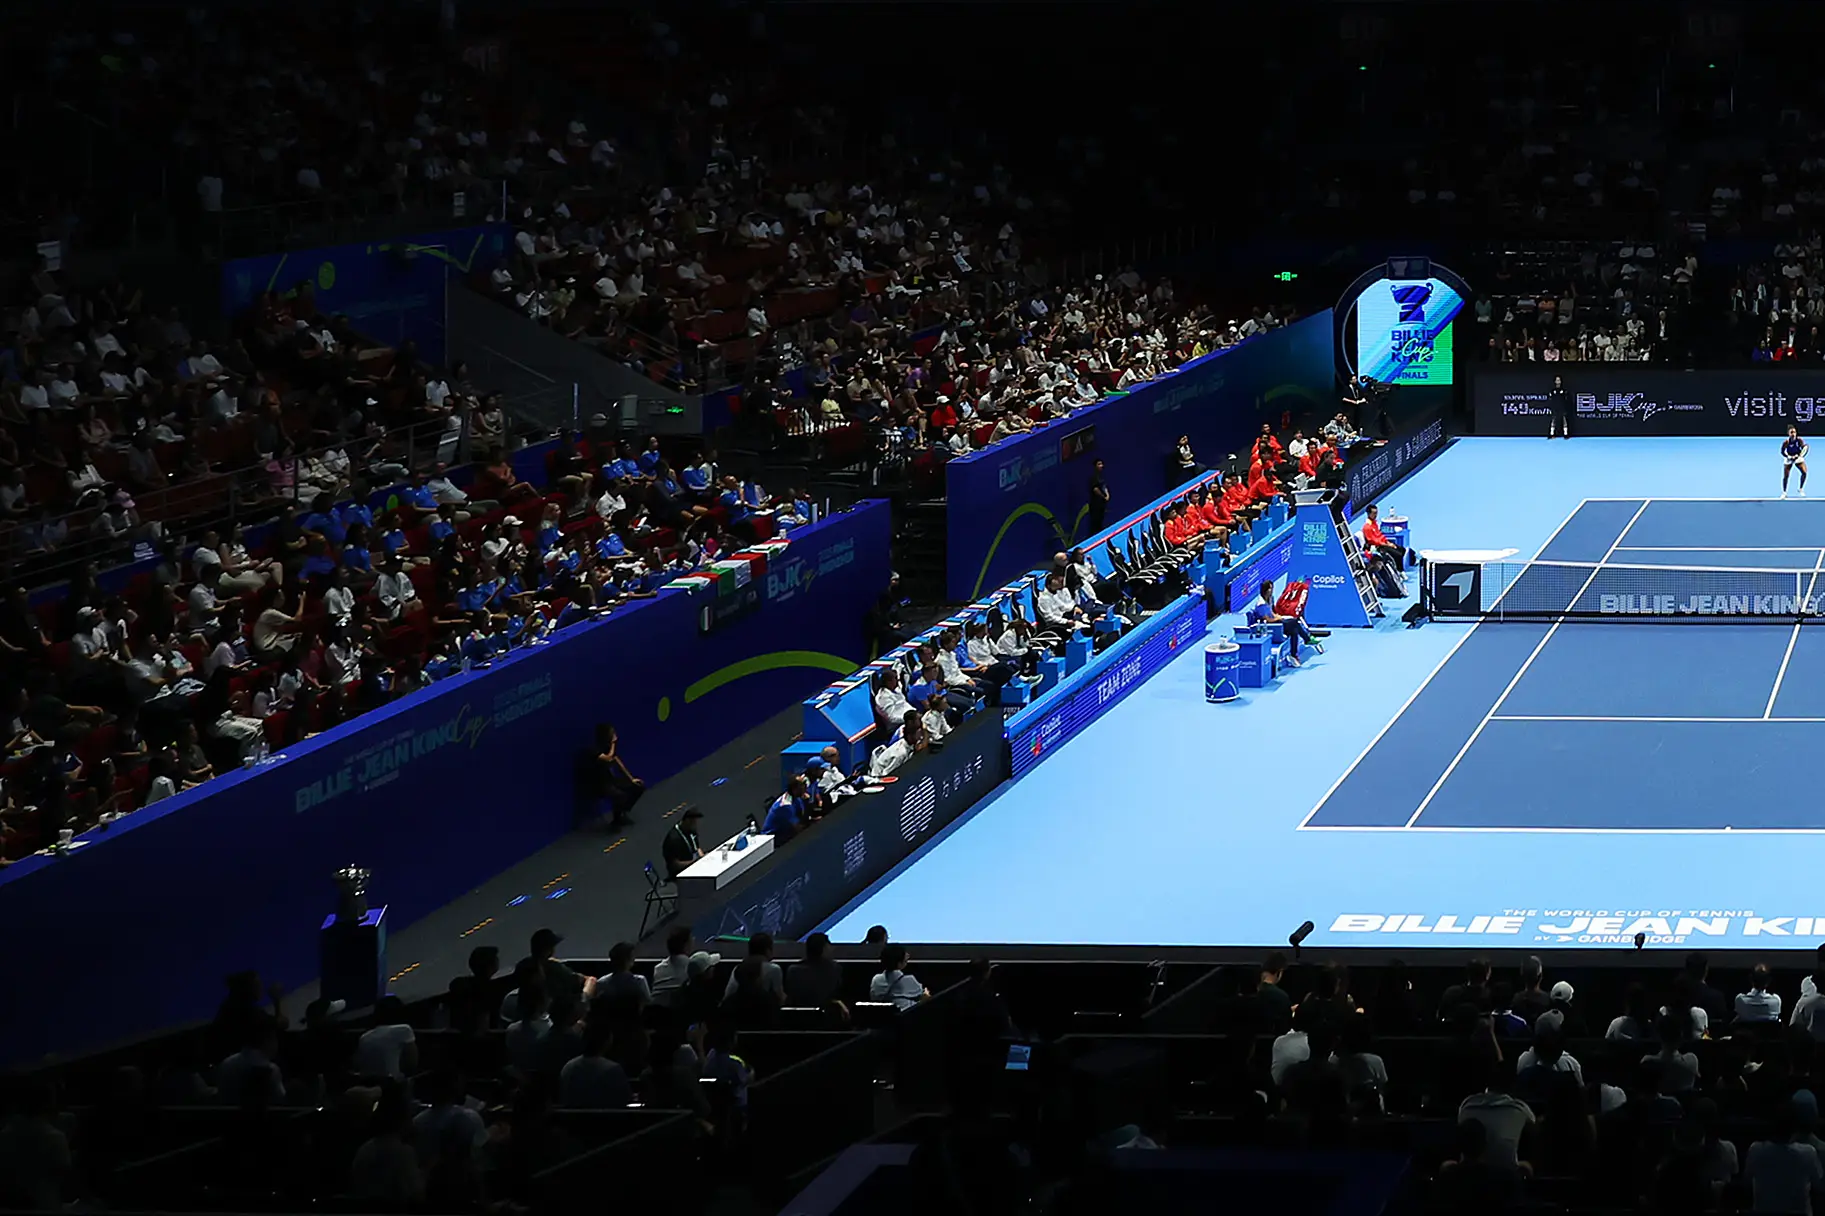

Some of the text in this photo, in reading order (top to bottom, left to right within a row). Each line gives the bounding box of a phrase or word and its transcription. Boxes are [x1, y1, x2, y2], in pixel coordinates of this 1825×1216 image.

[1576, 392, 1632, 413] BJK
[1724, 390, 1787, 417] visit
[1313, 574, 1345, 584] Copilot
[1600, 594, 1674, 614] BILLIE
[1679, 594, 1748, 614] JEAN
[1097, 672, 1120, 704] TEAM
[295, 761, 353, 814] BILLIE
[357, 742, 410, 783] JEAN
[1329, 913, 1526, 934] BILLIE
[1538, 915, 1730, 935] JEAN
[1503, 909, 1536, 917] THE
[1544, 909, 1610, 917] WORLD
[1614, 909, 1654, 917] CUP
[1689, 910, 1755, 918] TENNIS
